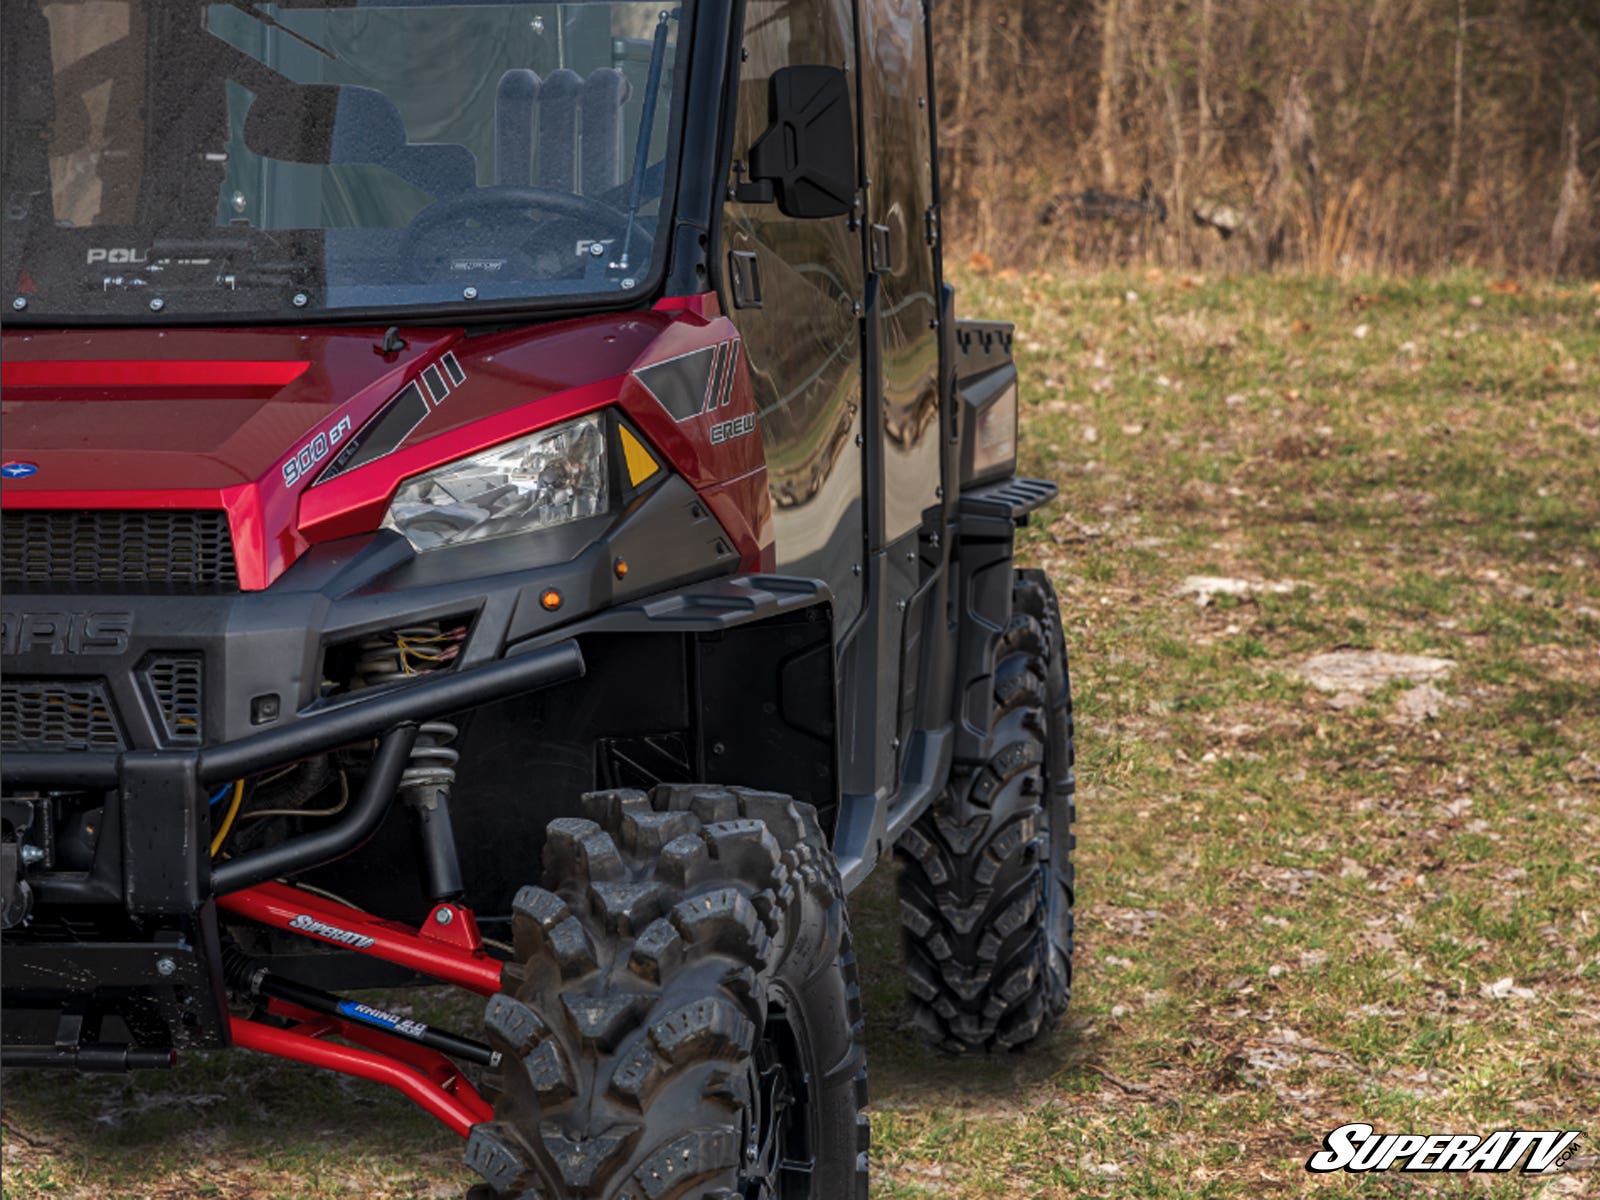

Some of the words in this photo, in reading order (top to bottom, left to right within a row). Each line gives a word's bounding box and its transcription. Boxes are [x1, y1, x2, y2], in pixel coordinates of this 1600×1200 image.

[282, 431, 329, 488] 900
[328, 414, 352, 446] EFI
[710, 412, 756, 445] CREW
